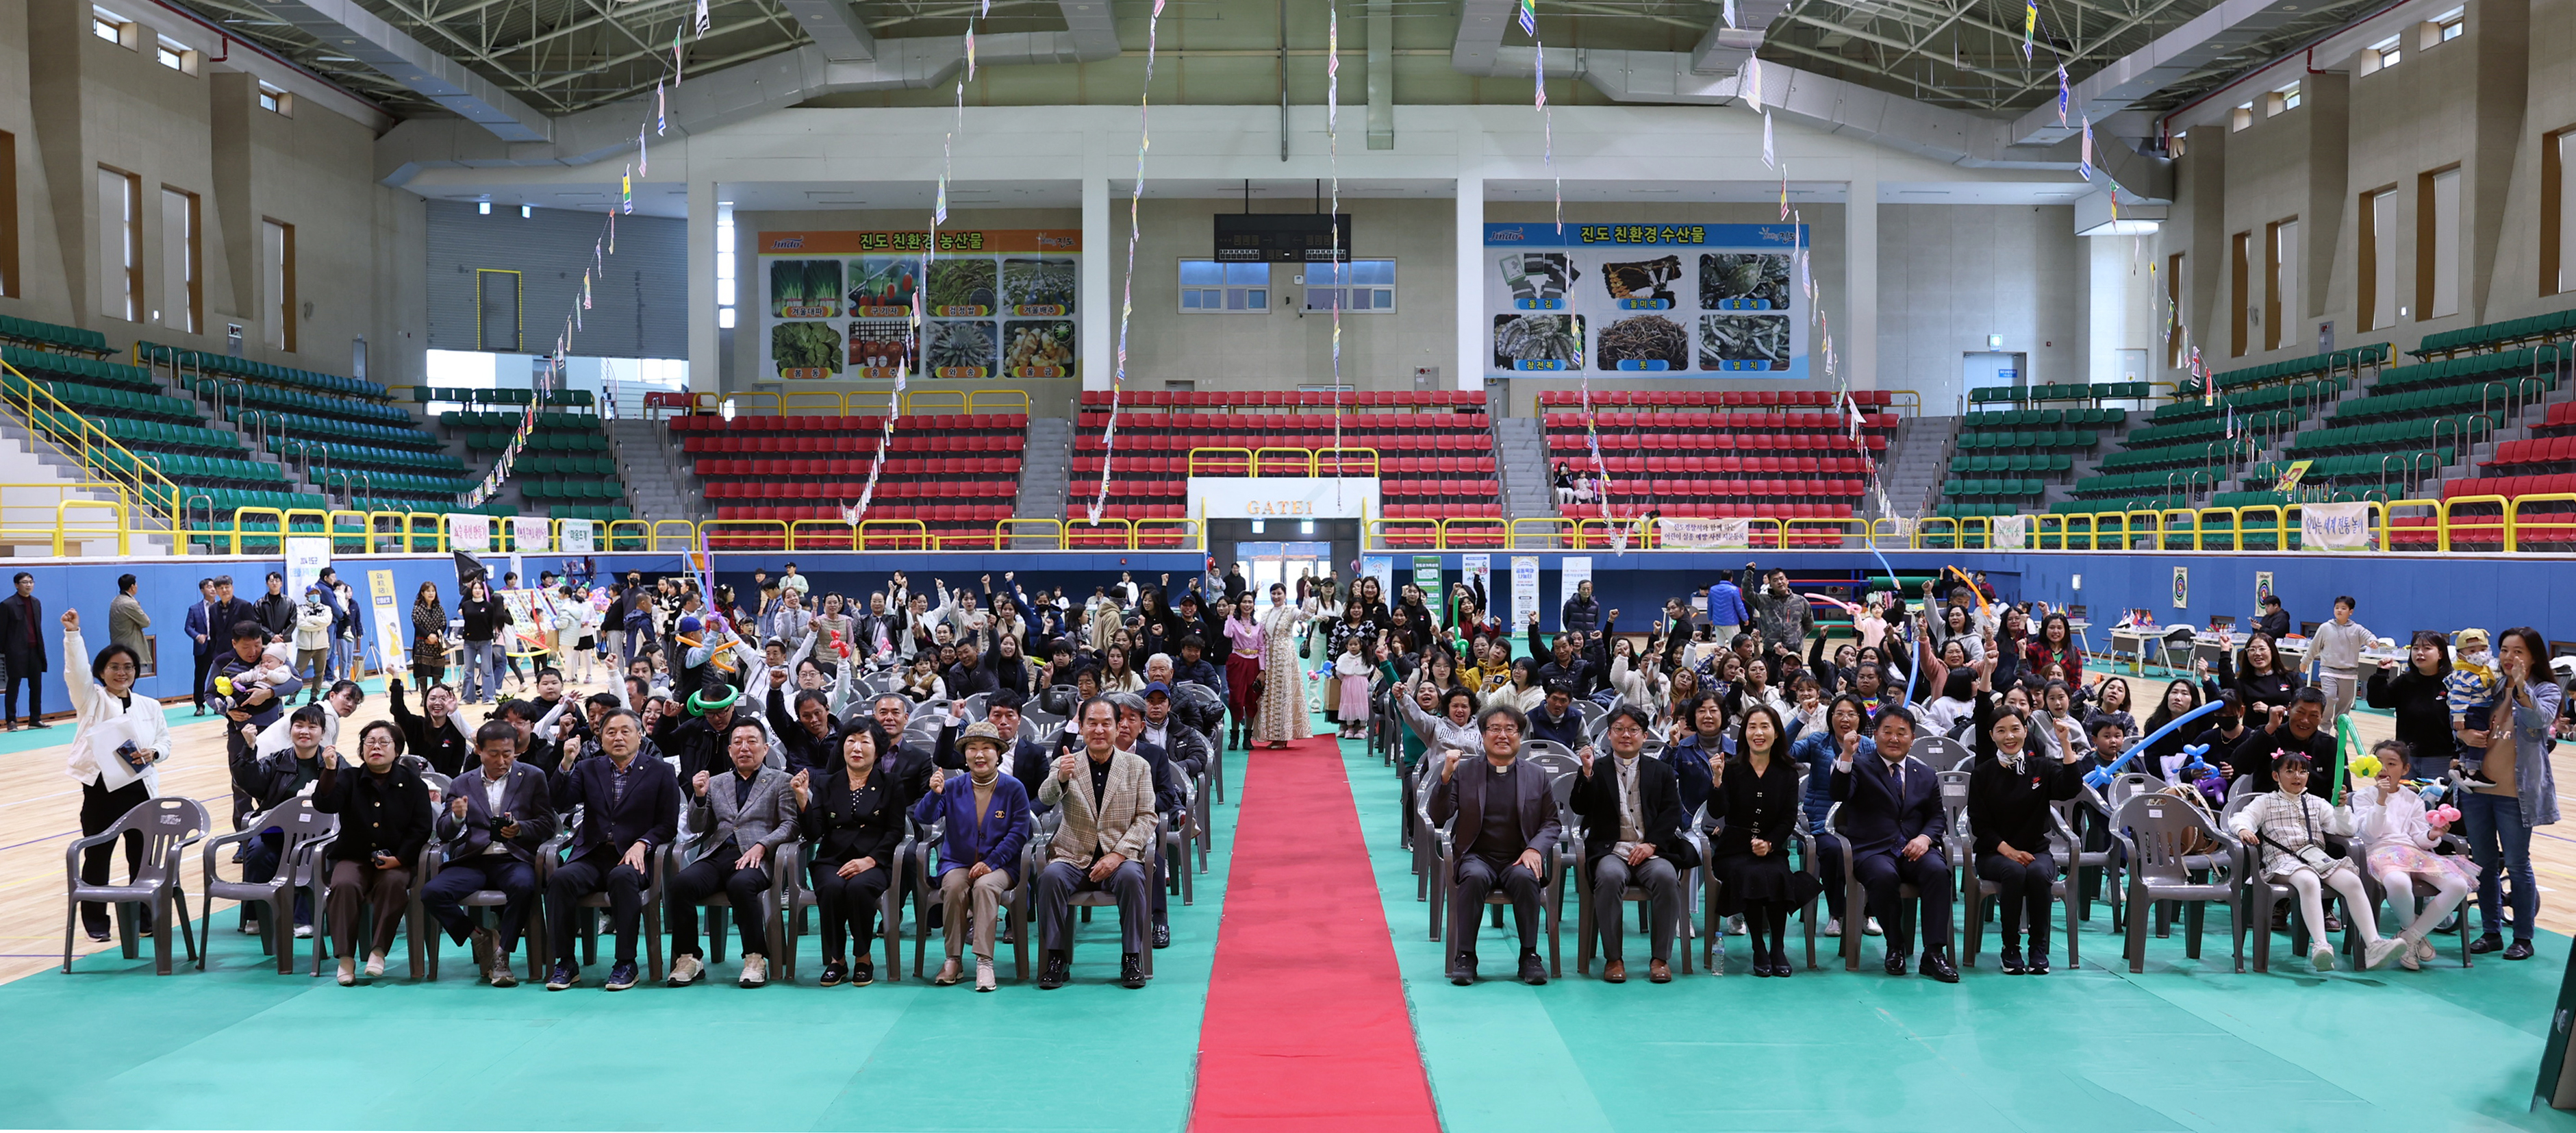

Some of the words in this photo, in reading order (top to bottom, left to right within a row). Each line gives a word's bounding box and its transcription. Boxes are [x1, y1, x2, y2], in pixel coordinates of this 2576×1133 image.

[1488, 229, 1519, 241] Jindo
[1581, 227, 1610, 242] 진도
[1615, 227, 1657, 243] 친환경
[1660, 227, 1704, 243] 수산물
[1780, 232, 1795, 242] 진도
[770, 236, 800, 249] Jindo
[860, 234, 888, 250] 진도
[893, 234, 935, 249] 친환경
[939, 233, 983, 249] 농산물
[1057, 236, 1076, 249] 진도
[1630, 300, 1657, 308] 돌미역
[792, 306, 822, 316] 겨울대파
[872, 306, 898, 315] 구기자
[950, 306, 975, 315] 검정쌀
[1024, 306, 1055, 314] 겨울배추
[1527, 361, 1554, 370] 참전복
[1674, 523, 1708, 532] 진도경찰서와
[1710, 523, 1722, 532] 함께
[2324, 516, 2336, 534] 세계
[2338, 516, 2350, 534] 전통
[2352, 515, 2363, 534] 놀이
[464, 525, 472, 538] 풍선
[473, 524, 486, 539] 만들기
[1664, 532, 1681, 540] 어린이
[1683, 532, 1695, 540] 실종
[1695, 532, 1708, 540] 예방
[1709, 532, 1721, 540] 사전
[1722, 532, 1745, 540] 지문등록
